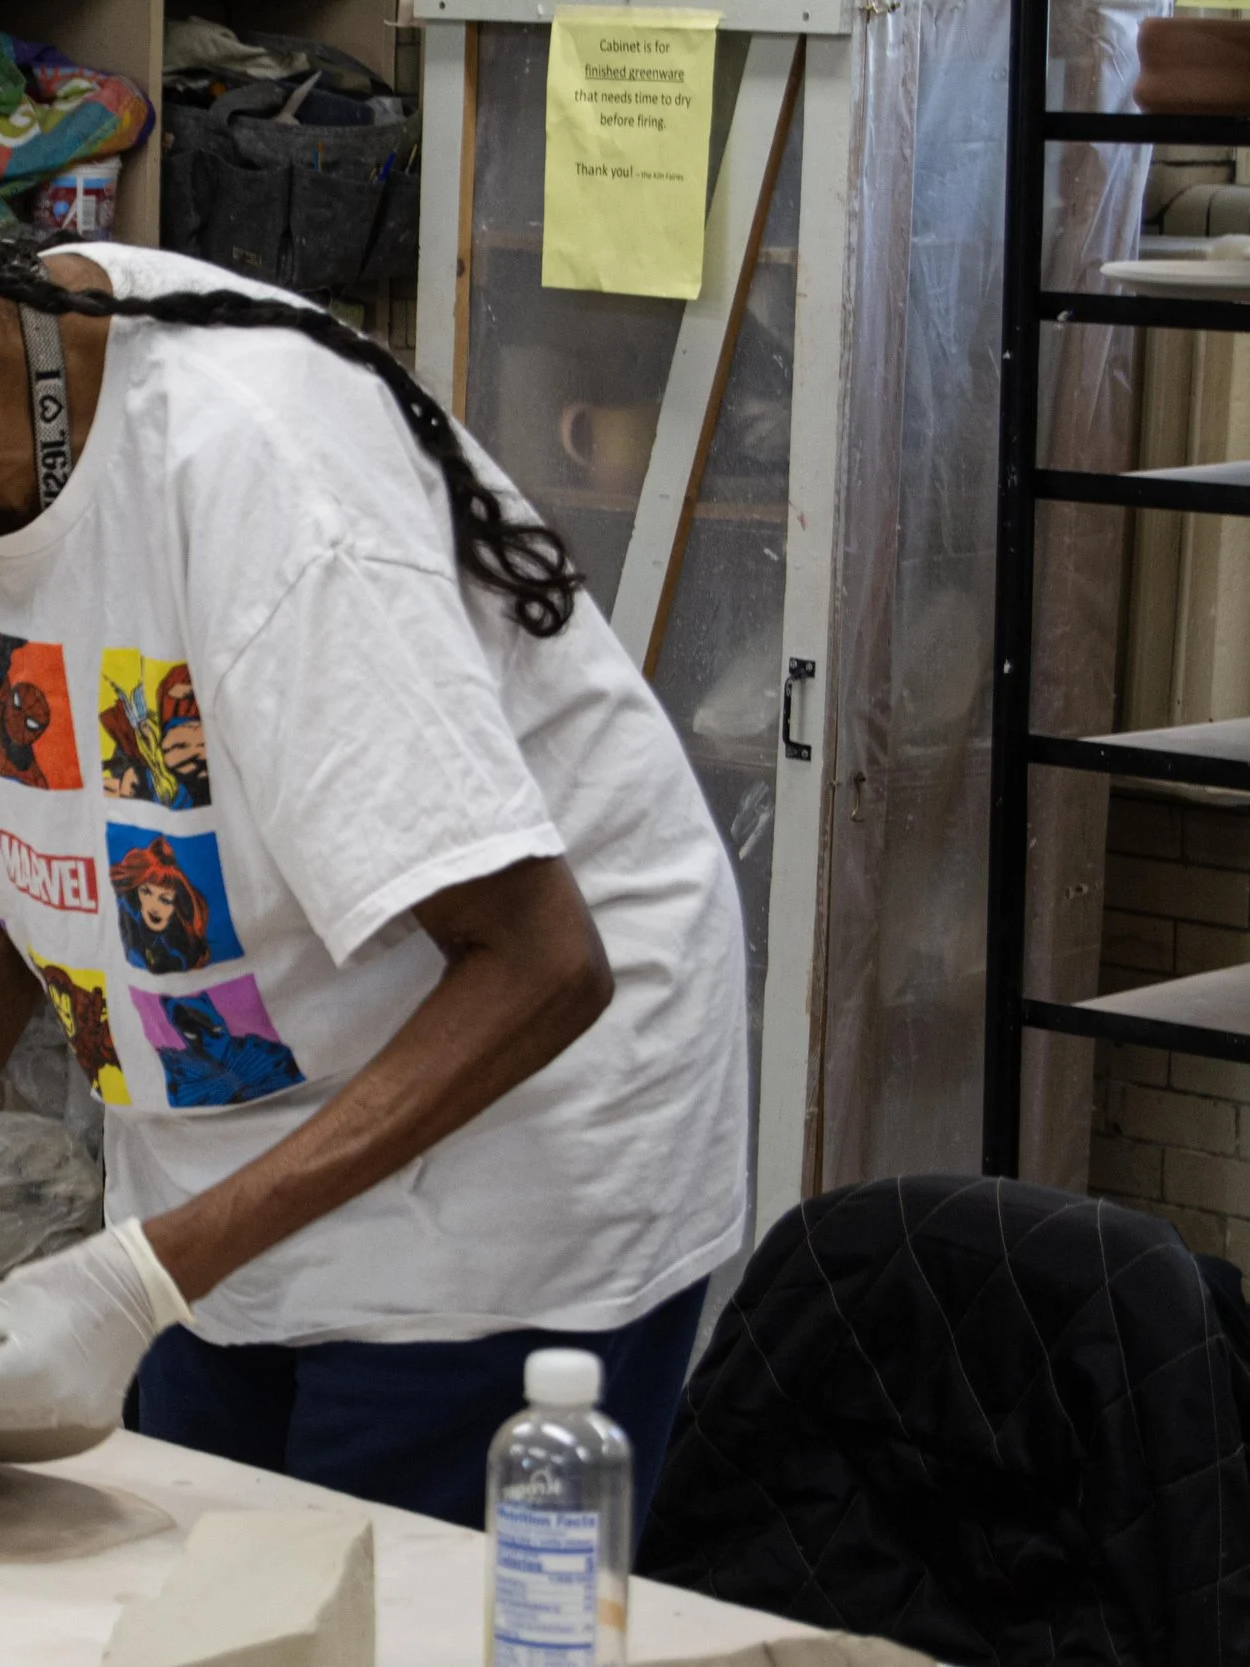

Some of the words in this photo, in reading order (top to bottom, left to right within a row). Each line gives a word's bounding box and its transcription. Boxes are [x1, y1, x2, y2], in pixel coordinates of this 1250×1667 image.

[600, 38, 640, 53] Cabinet
[643, 39, 652, 53] is
[655, 40, 670, 54] for
[585, 63, 626, 78] finished
[629, 68, 685, 81] greenware
[574, 88, 598, 103] that
[601, 90, 632, 104] needs
[635, 92, 658, 105] time
[661, 93, 672, 106] to
[674, 93, 691, 108] dry
[600, 112, 635, 127] before
[637, 113, 667, 132] firing.
[575, 161, 608, 177] Thank
[611, 165, 633, 180] you!
[555, 1514, 596, 1527] Facts
